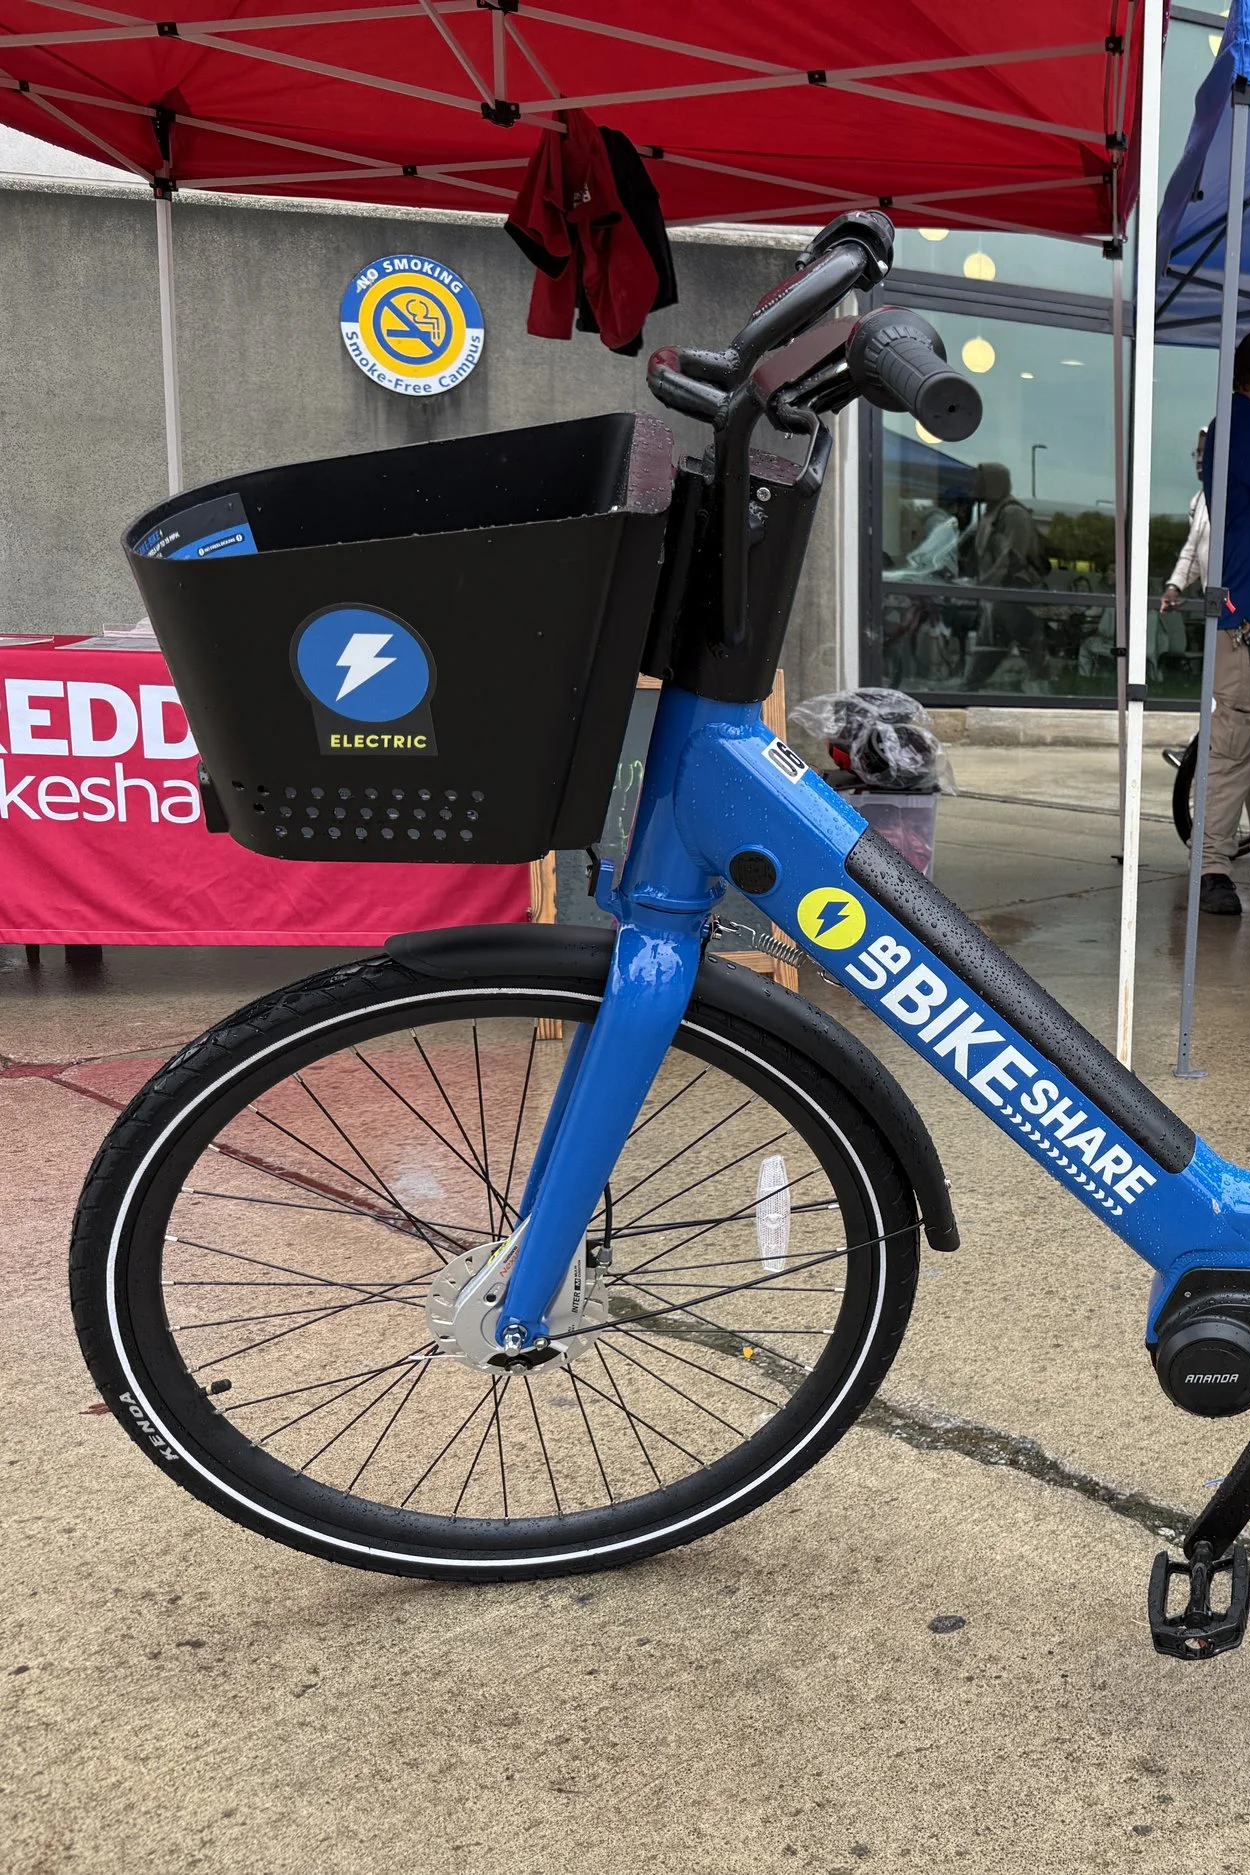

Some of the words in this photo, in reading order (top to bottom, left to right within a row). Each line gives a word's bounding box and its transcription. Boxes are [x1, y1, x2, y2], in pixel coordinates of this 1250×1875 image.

[357, 268, 379, 292] NO
[383, 258, 464, 294] SMOKING
[346, 331, 432, 394] Smoke-Free
[439, 335, 481, 389] Campus
[0, 678, 200, 760] EDD
[330, 734, 427, 749] ELECTRIC
[768, 741, 805, 778] 06
[845, 935, 911, 990] UB
[572, 1292, 581, 1313] INTER
[1185, 1373, 1239, 1384] ANANDA
[119, 1391, 179, 1460] KENDA
